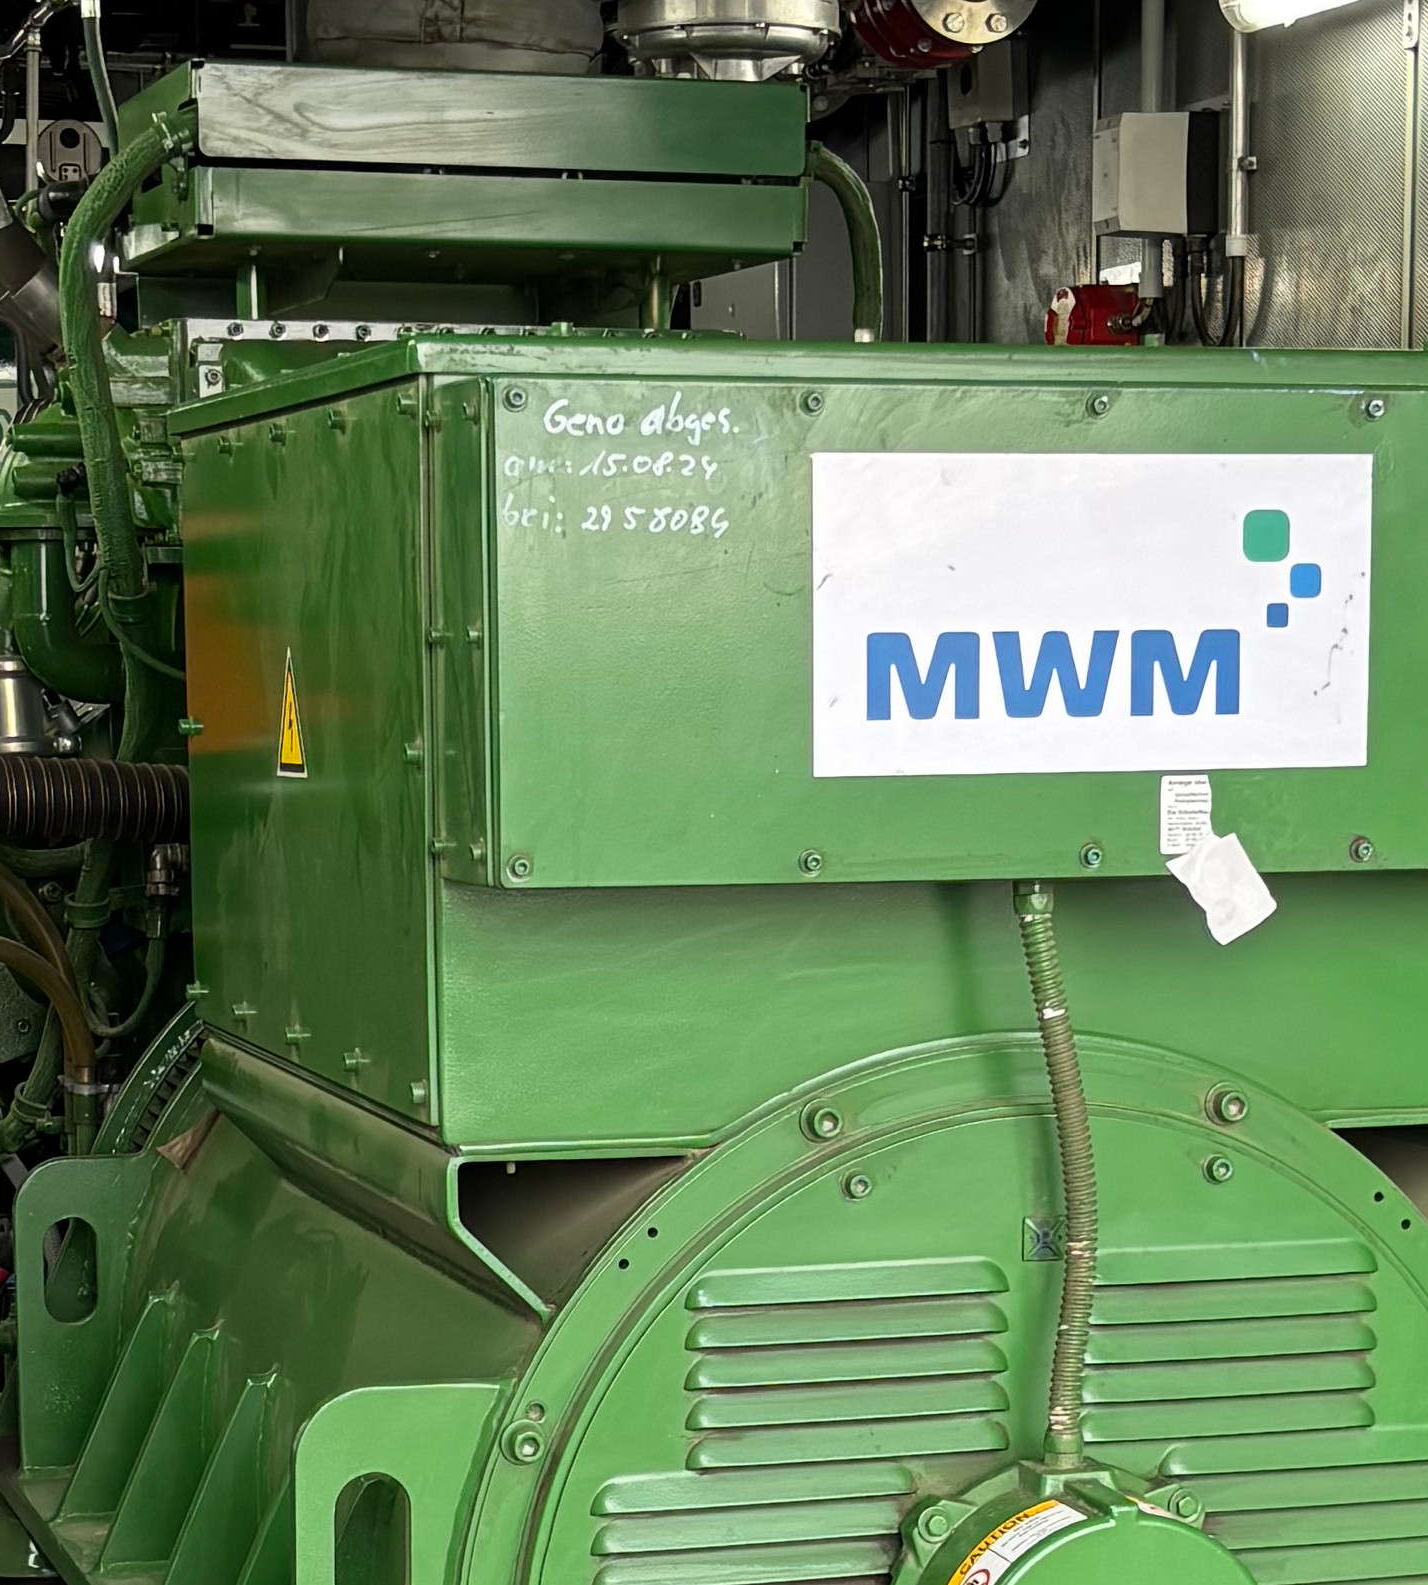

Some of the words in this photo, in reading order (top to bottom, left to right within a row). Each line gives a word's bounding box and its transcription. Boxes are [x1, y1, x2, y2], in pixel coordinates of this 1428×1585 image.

[543, 398, 625, 436] Geno
[640, 391, 740, 446] abges.
[579, 450, 719, 480] 15.08.24
[866, 629, 1241, 721] MWM
[960, 1513, 1031, 1575] CAUTION
